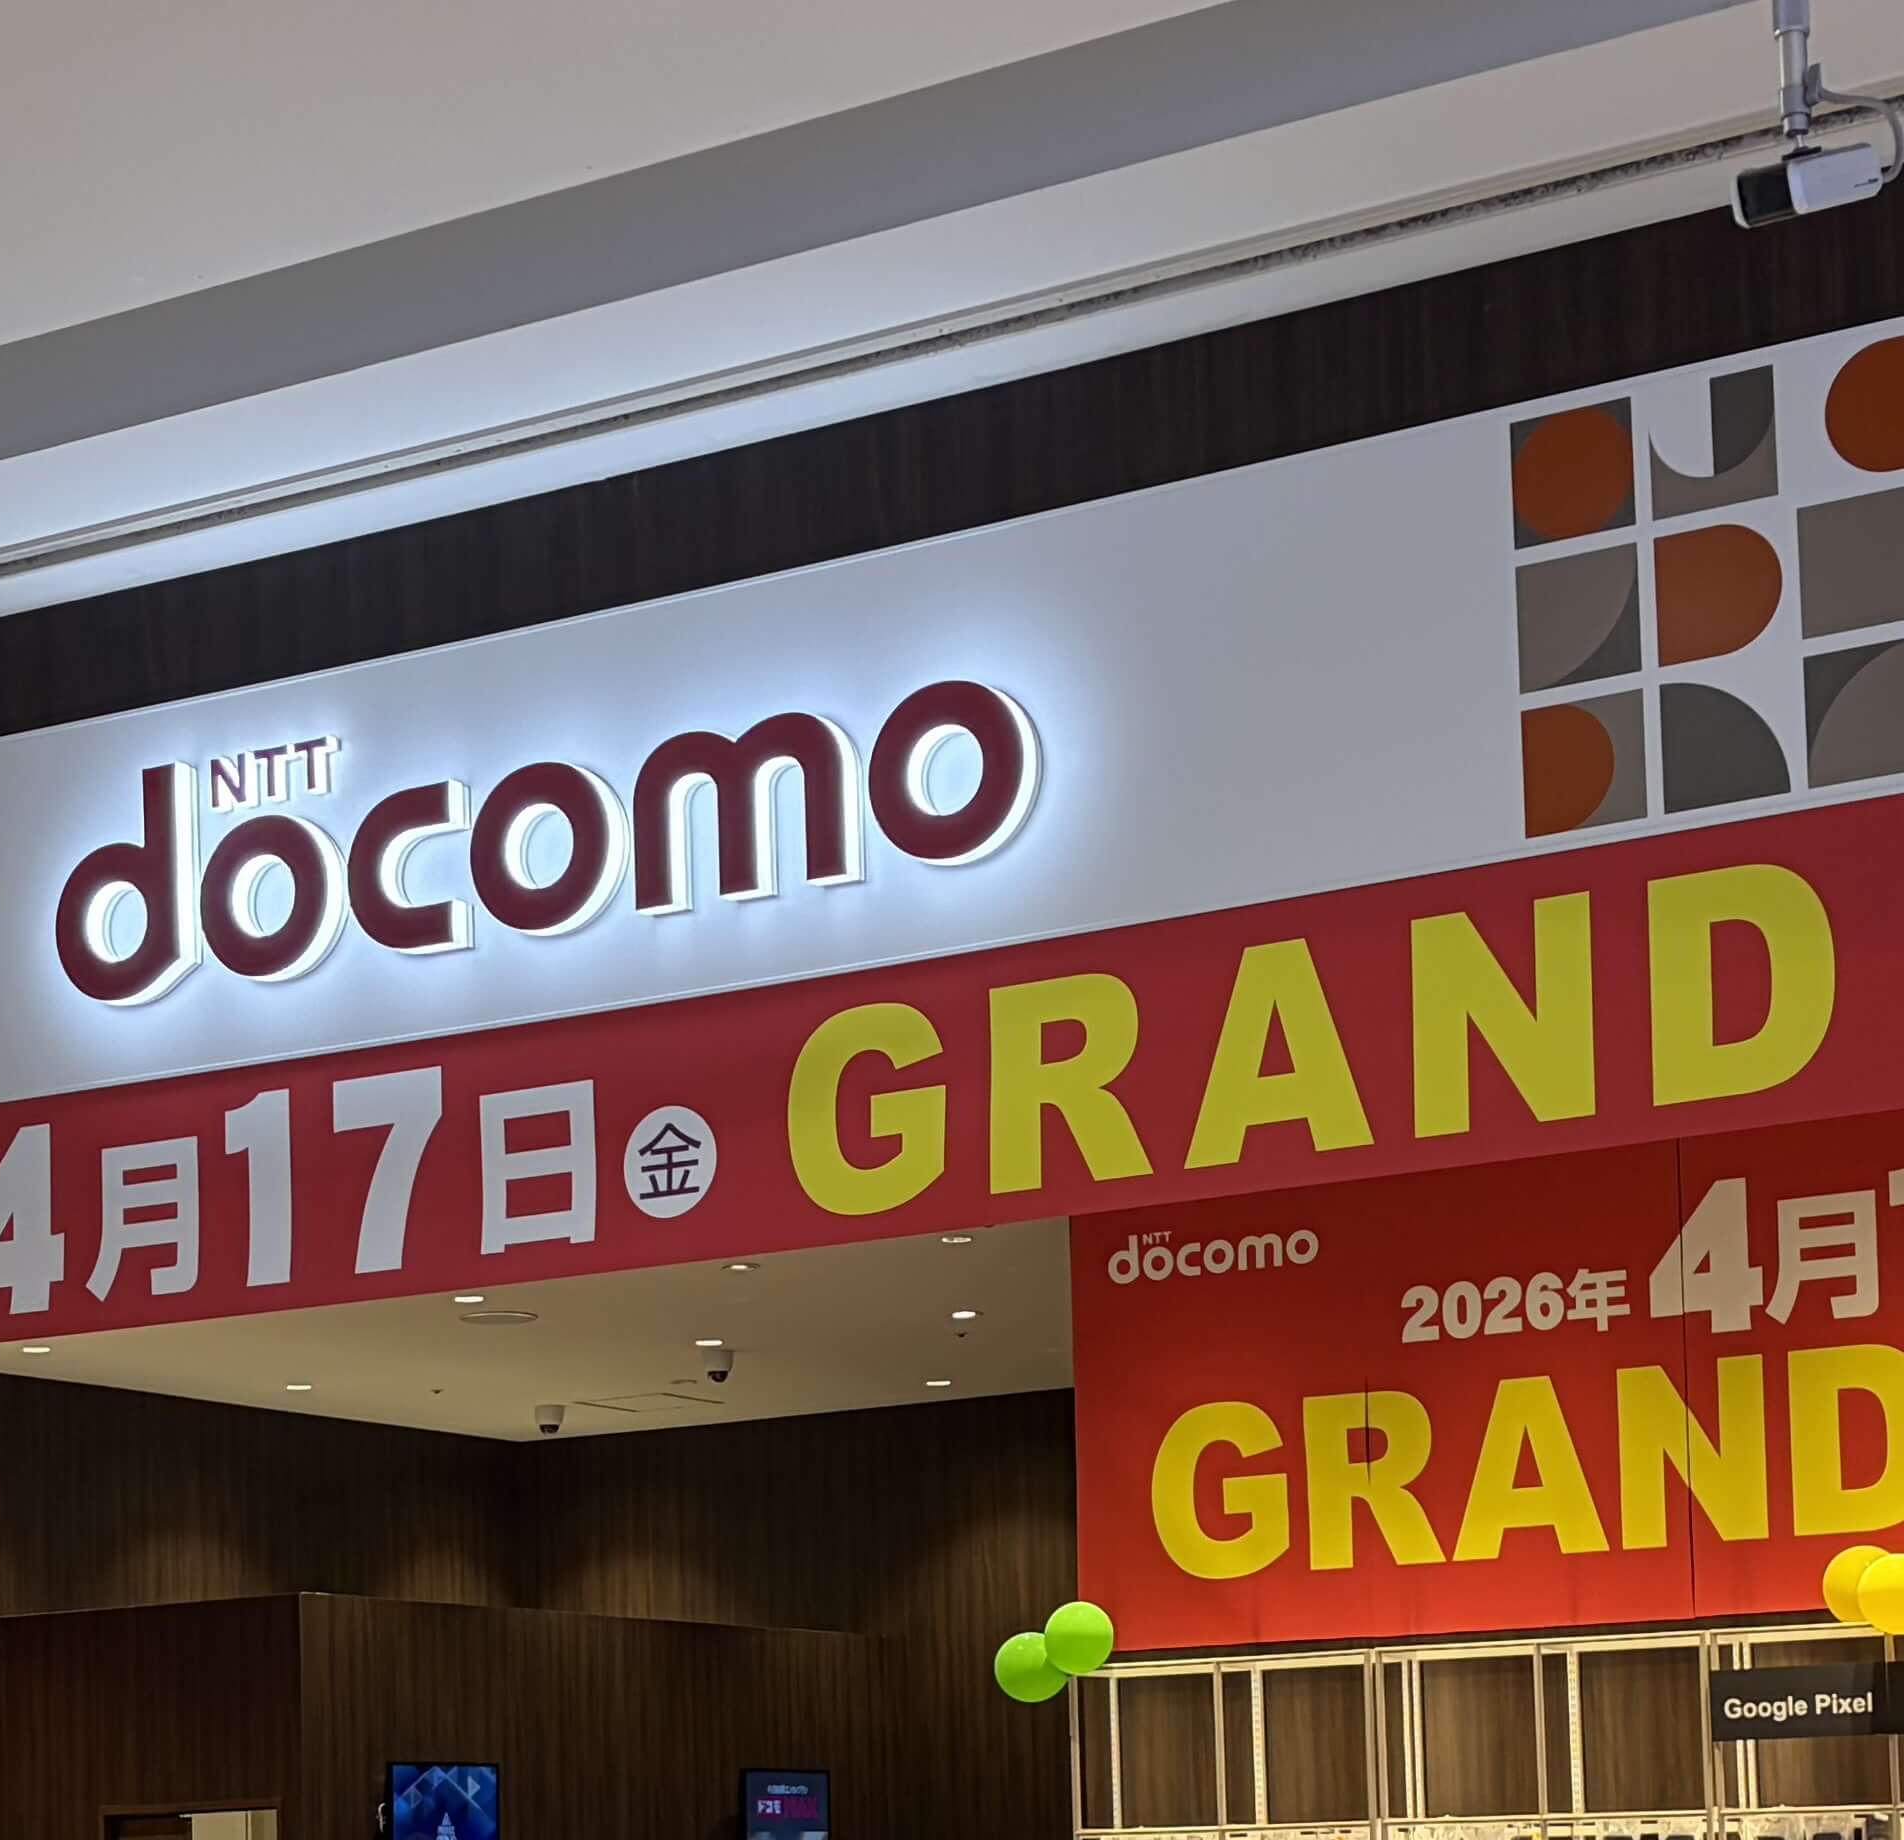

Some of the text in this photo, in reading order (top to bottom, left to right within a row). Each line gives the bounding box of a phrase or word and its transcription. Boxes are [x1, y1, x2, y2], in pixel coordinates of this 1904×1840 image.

[210, 734, 341, 810] NTT
[54, 678, 1043, 1008] docomo
[786, 862, 1836, 1217] GRAND
[1106, 1228, 1320, 1286] docomo
[1724, 1692, 1873, 1722] Google Pixel
